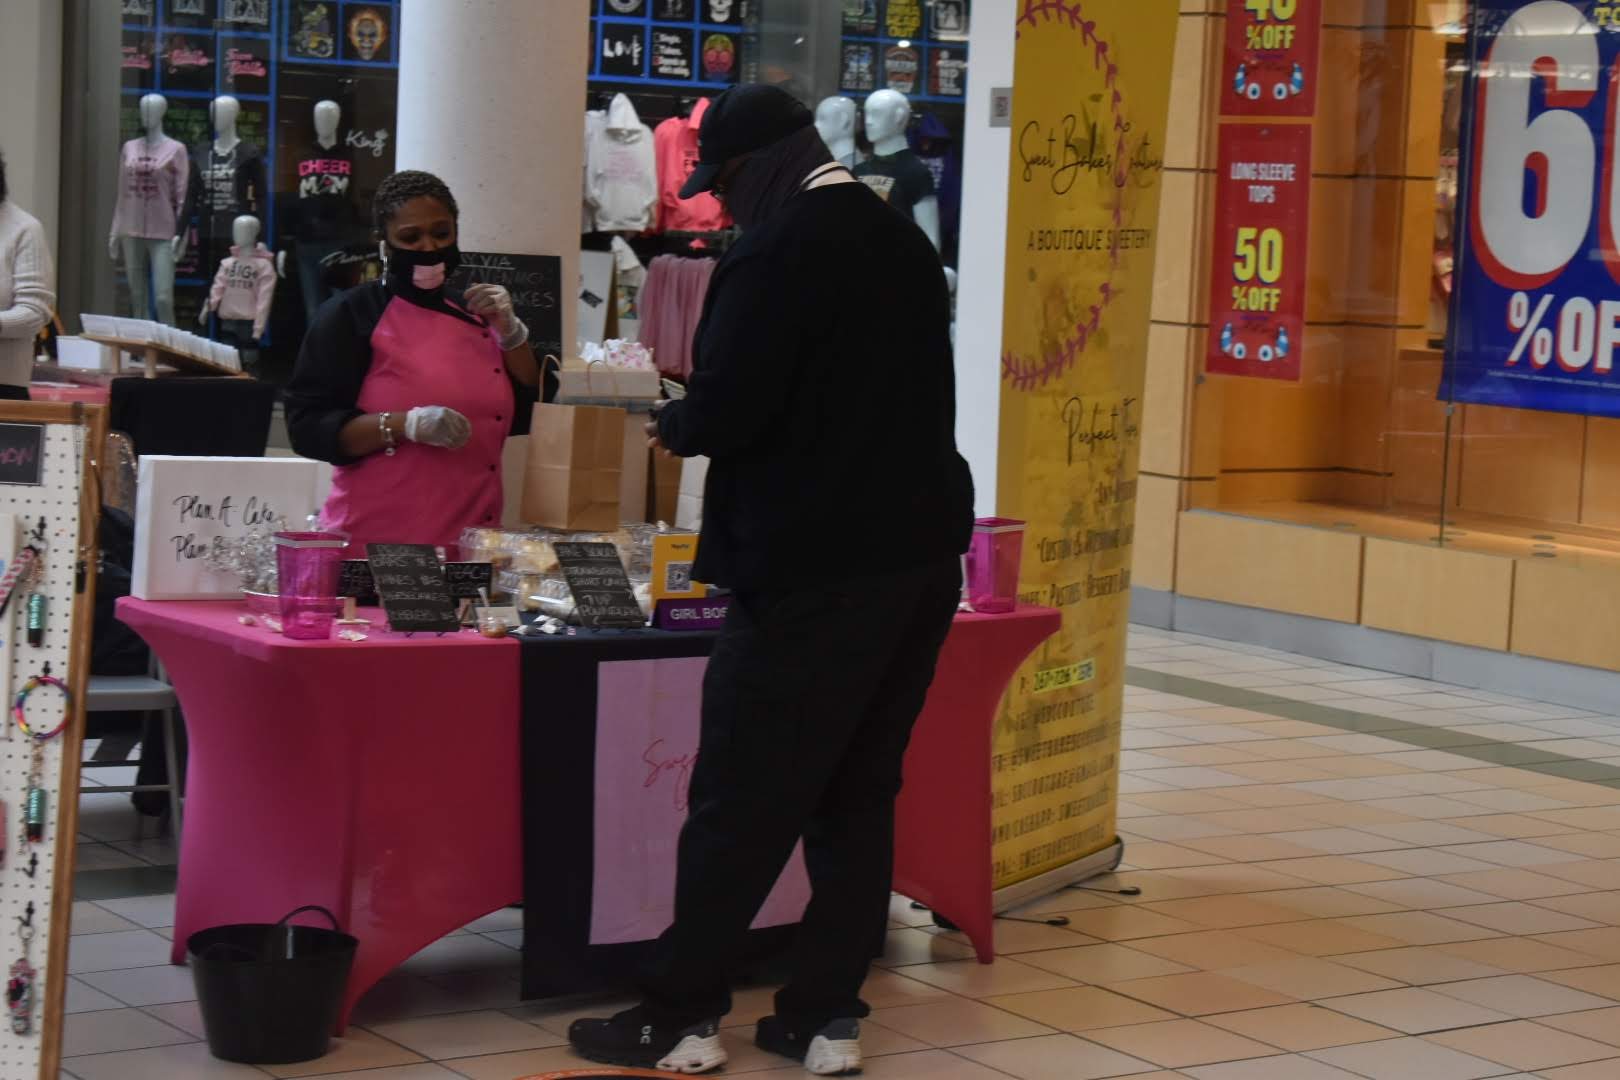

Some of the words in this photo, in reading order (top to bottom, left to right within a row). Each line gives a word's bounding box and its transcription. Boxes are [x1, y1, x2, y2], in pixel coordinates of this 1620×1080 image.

[1247, 25, 1296, 50] %OFF
[1472, 0, 1620, 292] 6
[299, 160, 352, 176] CHEER
[1231, 163, 1258, 180] LONG
[1259, 164, 1296, 182] SLEEVE
[1249, 186, 1275, 203] TOPS
[1037, 229, 1103, 251] BOUTIQUE
[1234, 227, 1284, 283] 50
[1232, 288, 1282, 313] %OFF
[173, 495, 213, 523] Plan
[669, 608, 700, 621] GIRL
[702, 606, 729, 620] BOS
